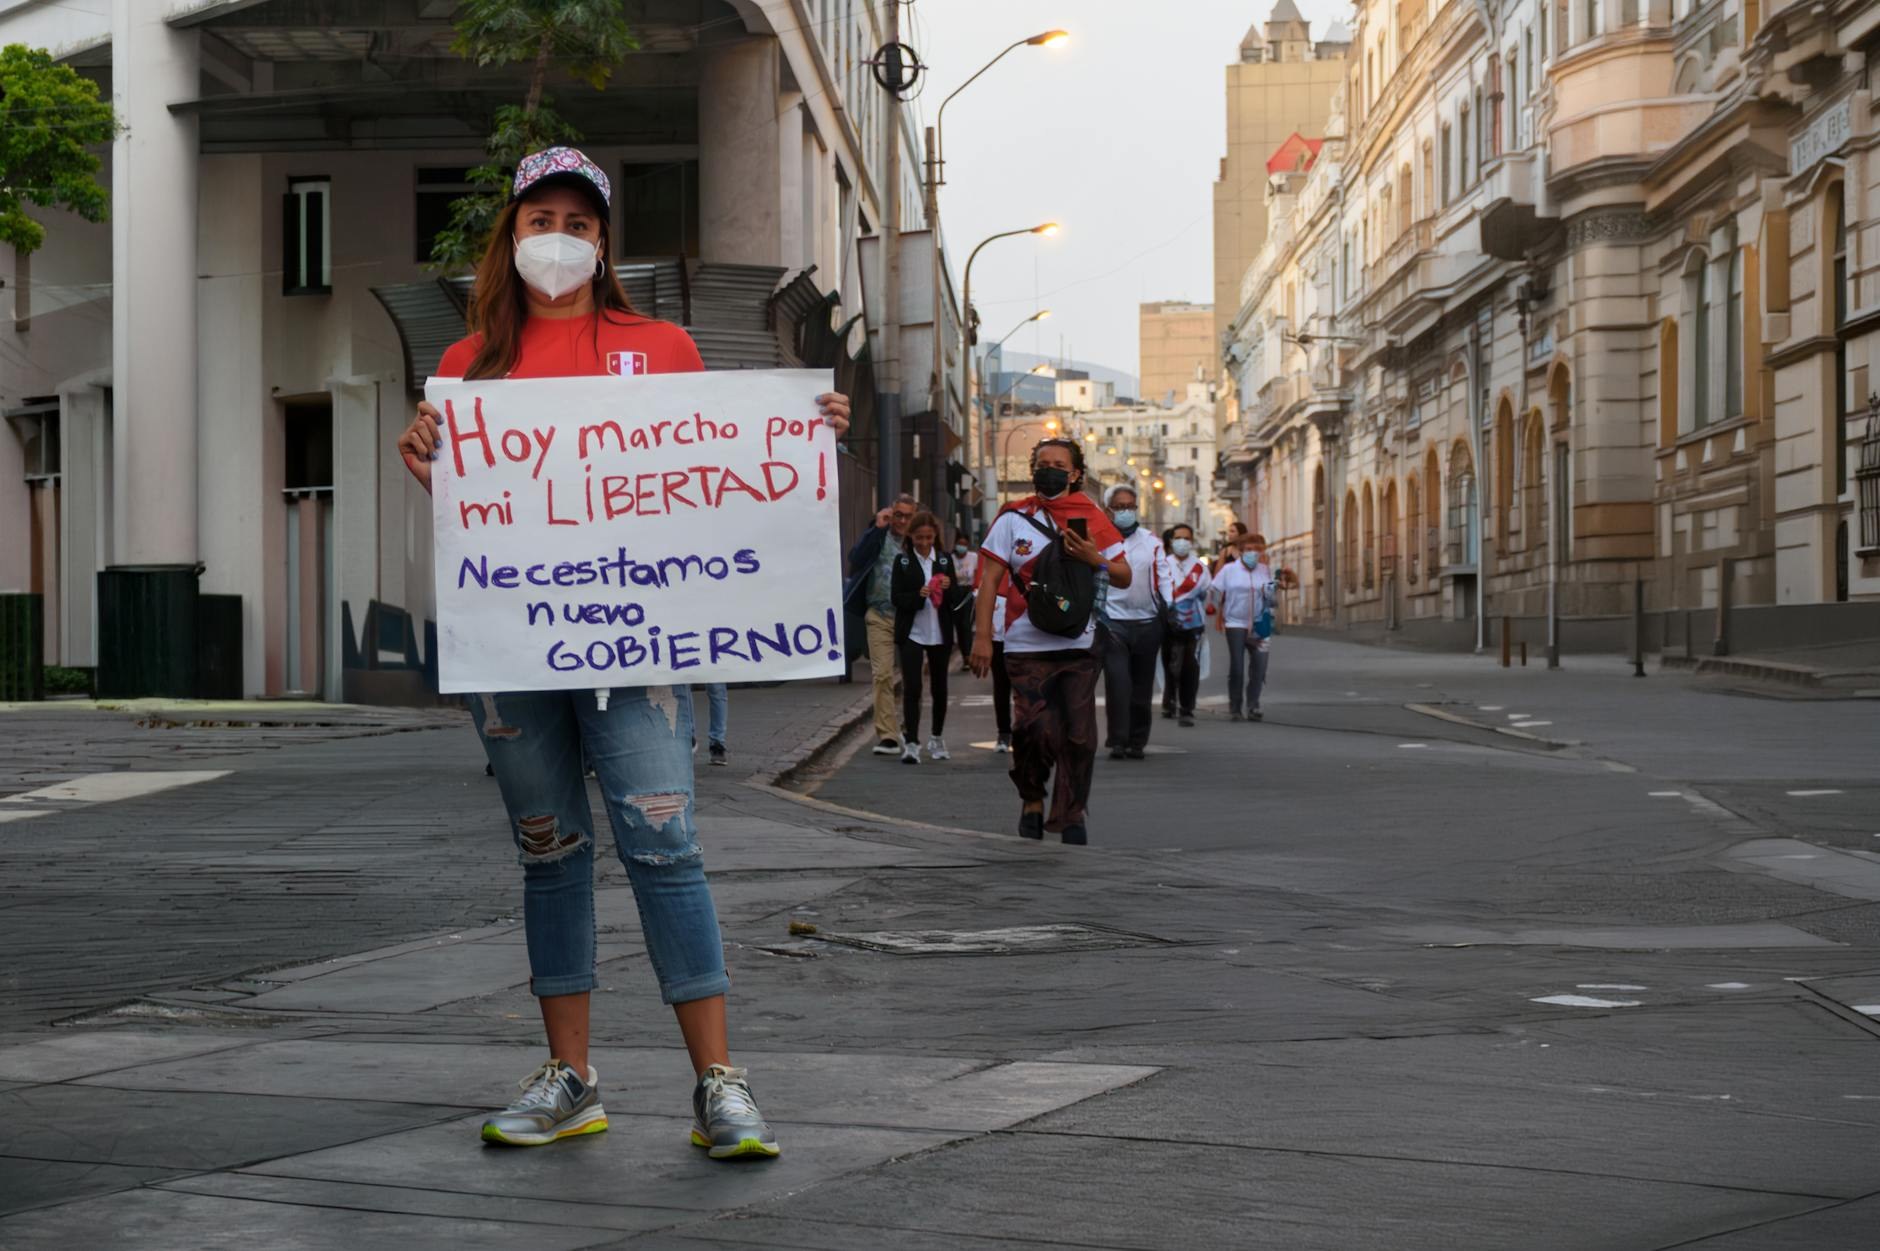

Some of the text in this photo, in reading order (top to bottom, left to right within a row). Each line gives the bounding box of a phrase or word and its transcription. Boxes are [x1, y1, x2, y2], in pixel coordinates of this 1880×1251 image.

[445, 397, 824, 479] Hoy marcho por
[460, 491, 513, 529] mi
[458, 547, 760, 589] Necesitamos
[527, 601, 645, 626] nuevo
